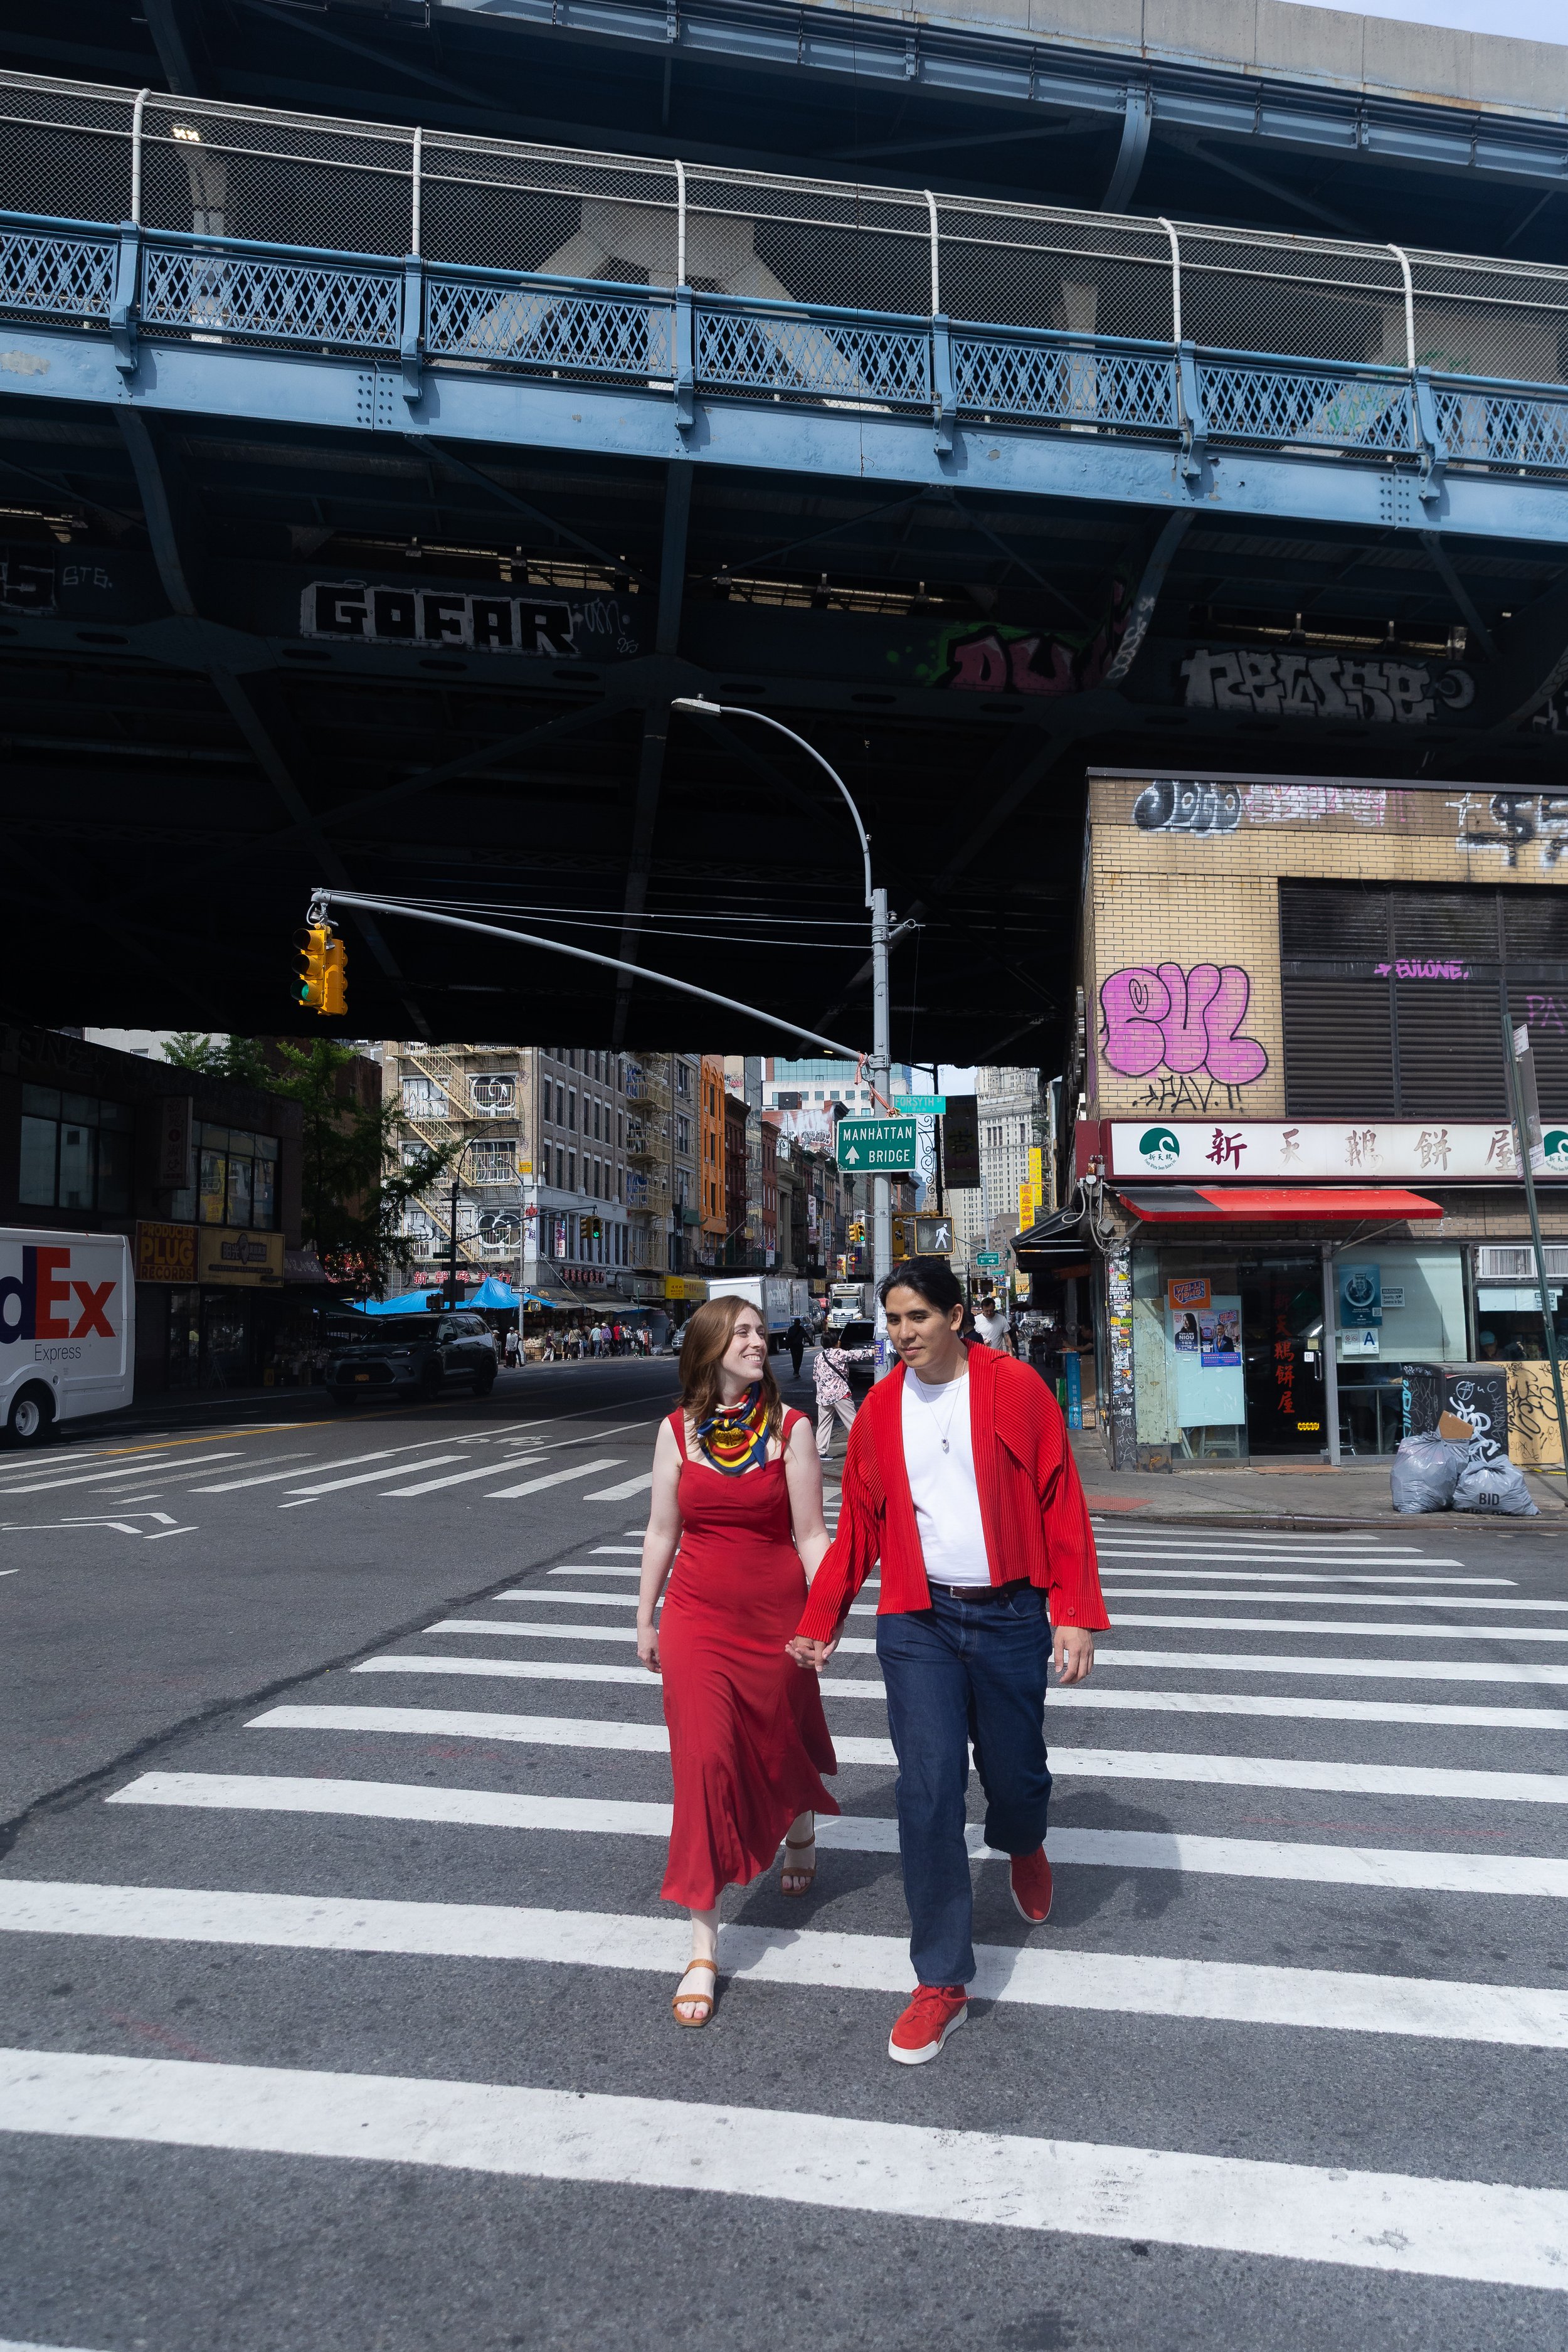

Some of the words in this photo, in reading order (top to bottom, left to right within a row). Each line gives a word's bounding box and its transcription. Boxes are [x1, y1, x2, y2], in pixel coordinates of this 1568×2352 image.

[895, 1096, 934, 1106] FORSYTH
[843, 1126, 913, 1142] MANHATTAN
[869, 1149, 910, 1163] BRIDGE
[1205, 1128, 1518, 1172] 新天鵝餅屋
[140, 1223, 194, 1239] PRODUCER
[140, 1236, 194, 1266] PLUG
[141, 1266, 193, 1279] RECORDS
[1364, 1332, 1375, 1345] A
[34, 1344, 82, 1364] Express
[1479, 1493, 1500, 1505] BID
